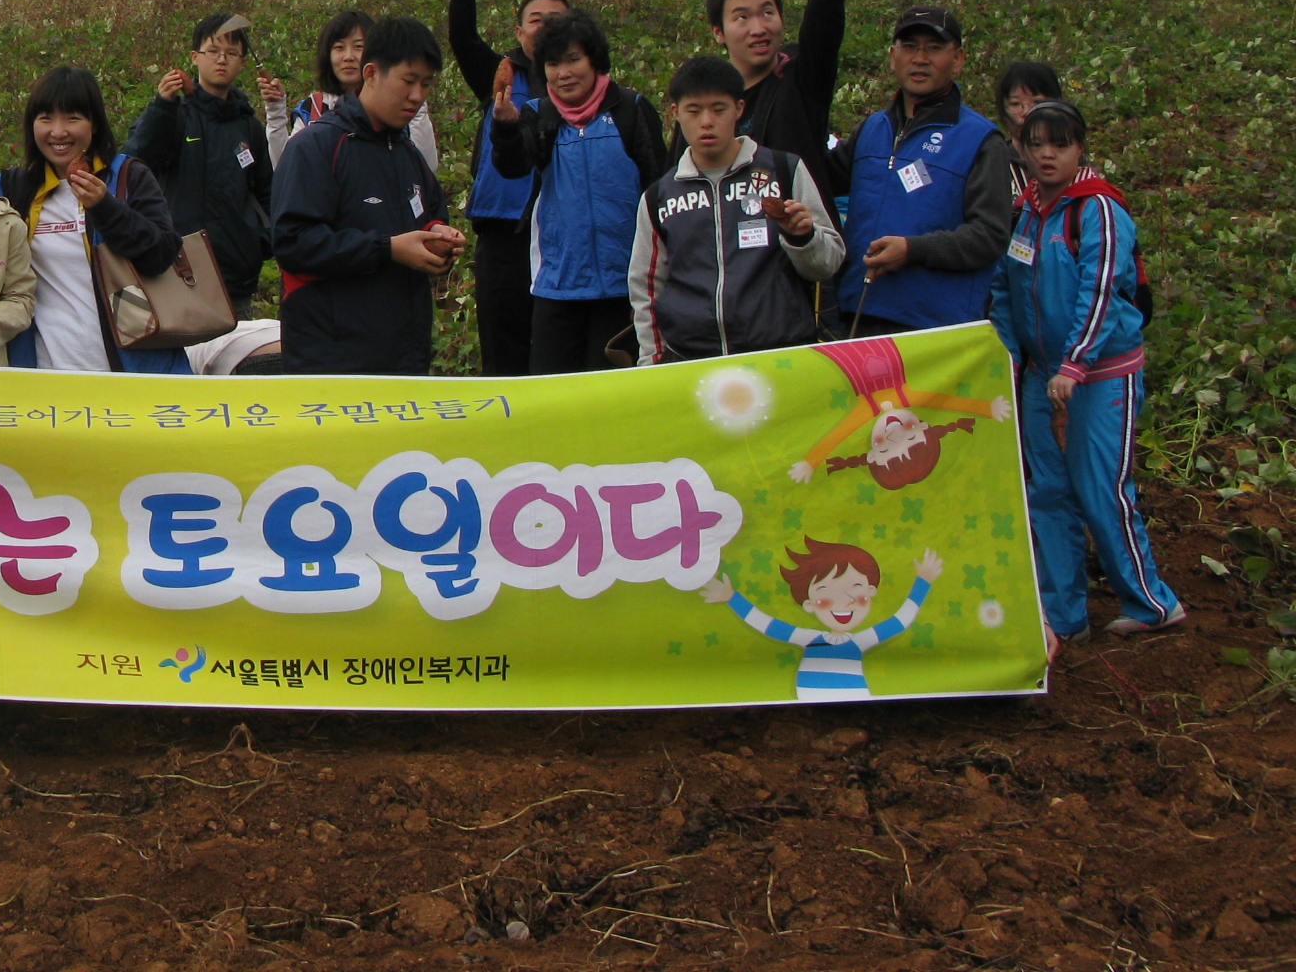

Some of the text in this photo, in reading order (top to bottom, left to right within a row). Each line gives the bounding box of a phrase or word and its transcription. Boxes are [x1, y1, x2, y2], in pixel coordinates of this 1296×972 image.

[150, 404, 278, 428] 즐거운
[300, 396, 511, 425] 주말만들기
[142, 472, 721, 598] 토요일이다
[78, 654, 509, 688] 지원 서울특별시 장애인복지과
